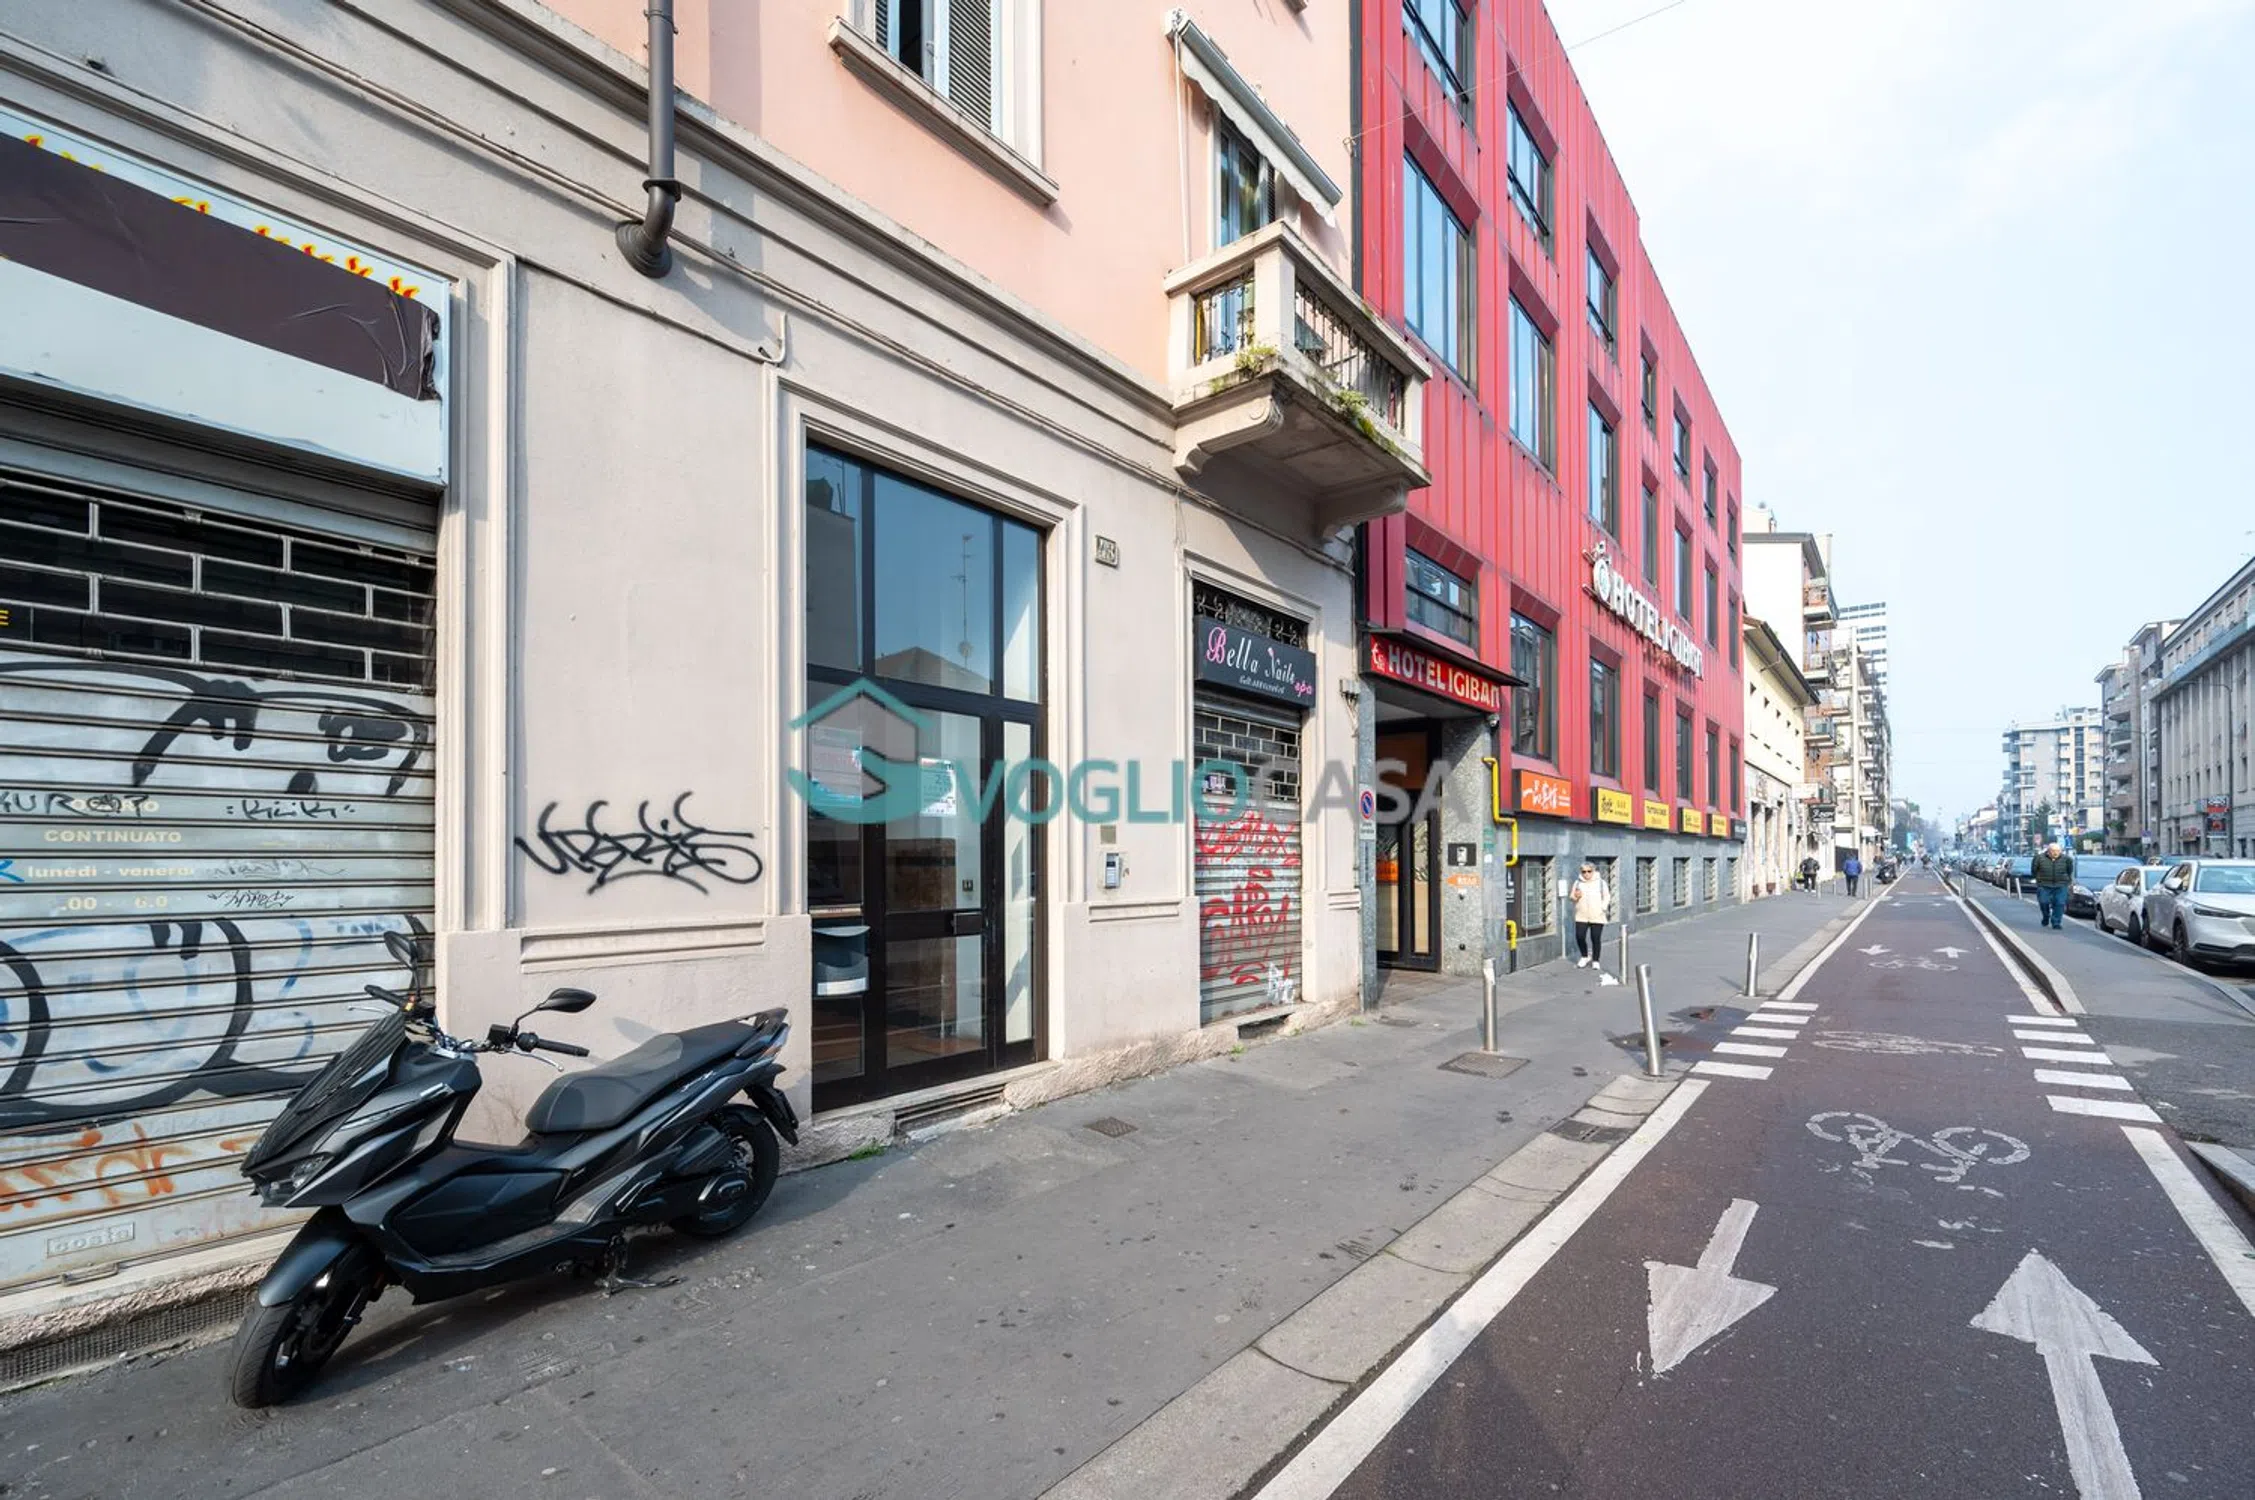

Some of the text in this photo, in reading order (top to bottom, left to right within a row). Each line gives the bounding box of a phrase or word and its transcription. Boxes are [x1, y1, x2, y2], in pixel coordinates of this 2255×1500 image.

[1610, 569, 1662, 648] HOTEL
[1206, 626, 1259, 675] Bella
[1388, 644, 1446, 691] HOTEL
[44, 830, 182, 843] CONTINUATO
